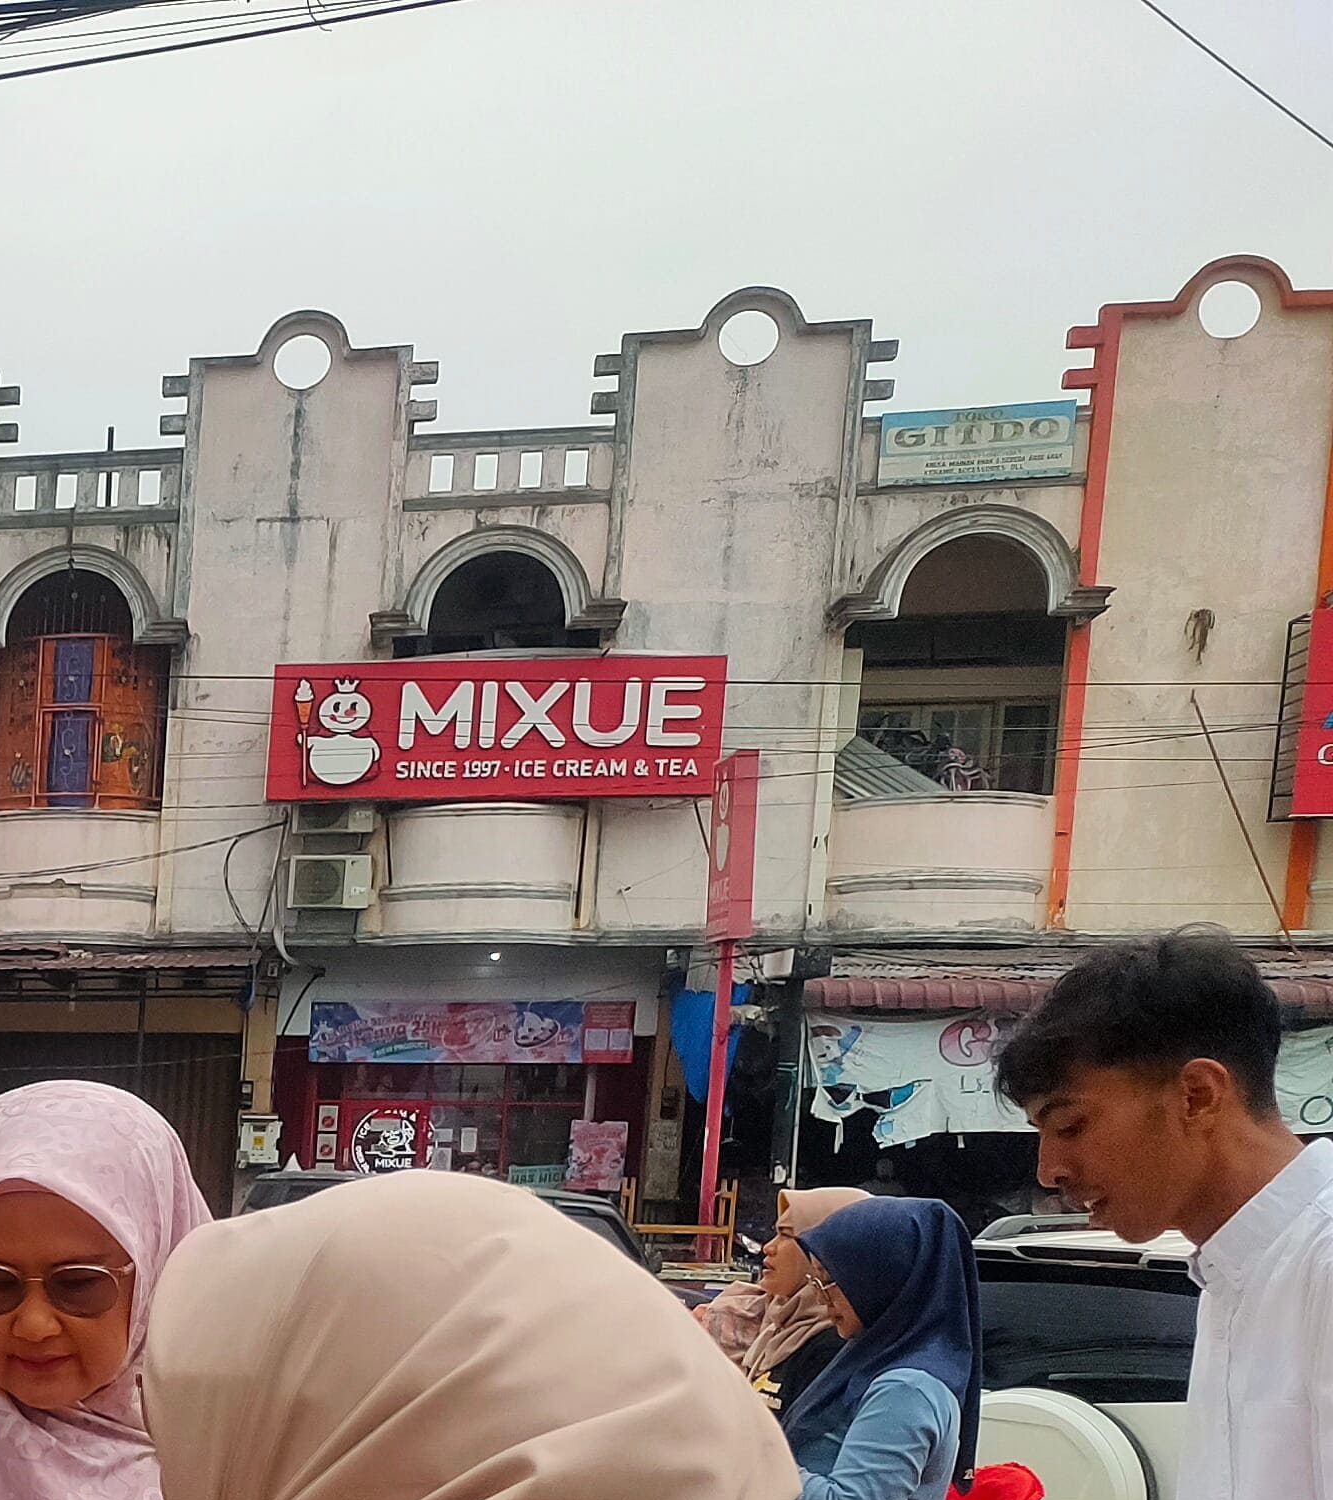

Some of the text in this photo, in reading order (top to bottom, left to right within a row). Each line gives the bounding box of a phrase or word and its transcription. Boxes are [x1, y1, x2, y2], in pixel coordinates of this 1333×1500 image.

[894, 417, 1061, 448] GITDO
[397, 676, 706, 751] MIXUE
[395, 758, 699, 779] SINCE 1997 ICE CREAM & TEA
[375, 1157, 413, 1168] MIXUE
